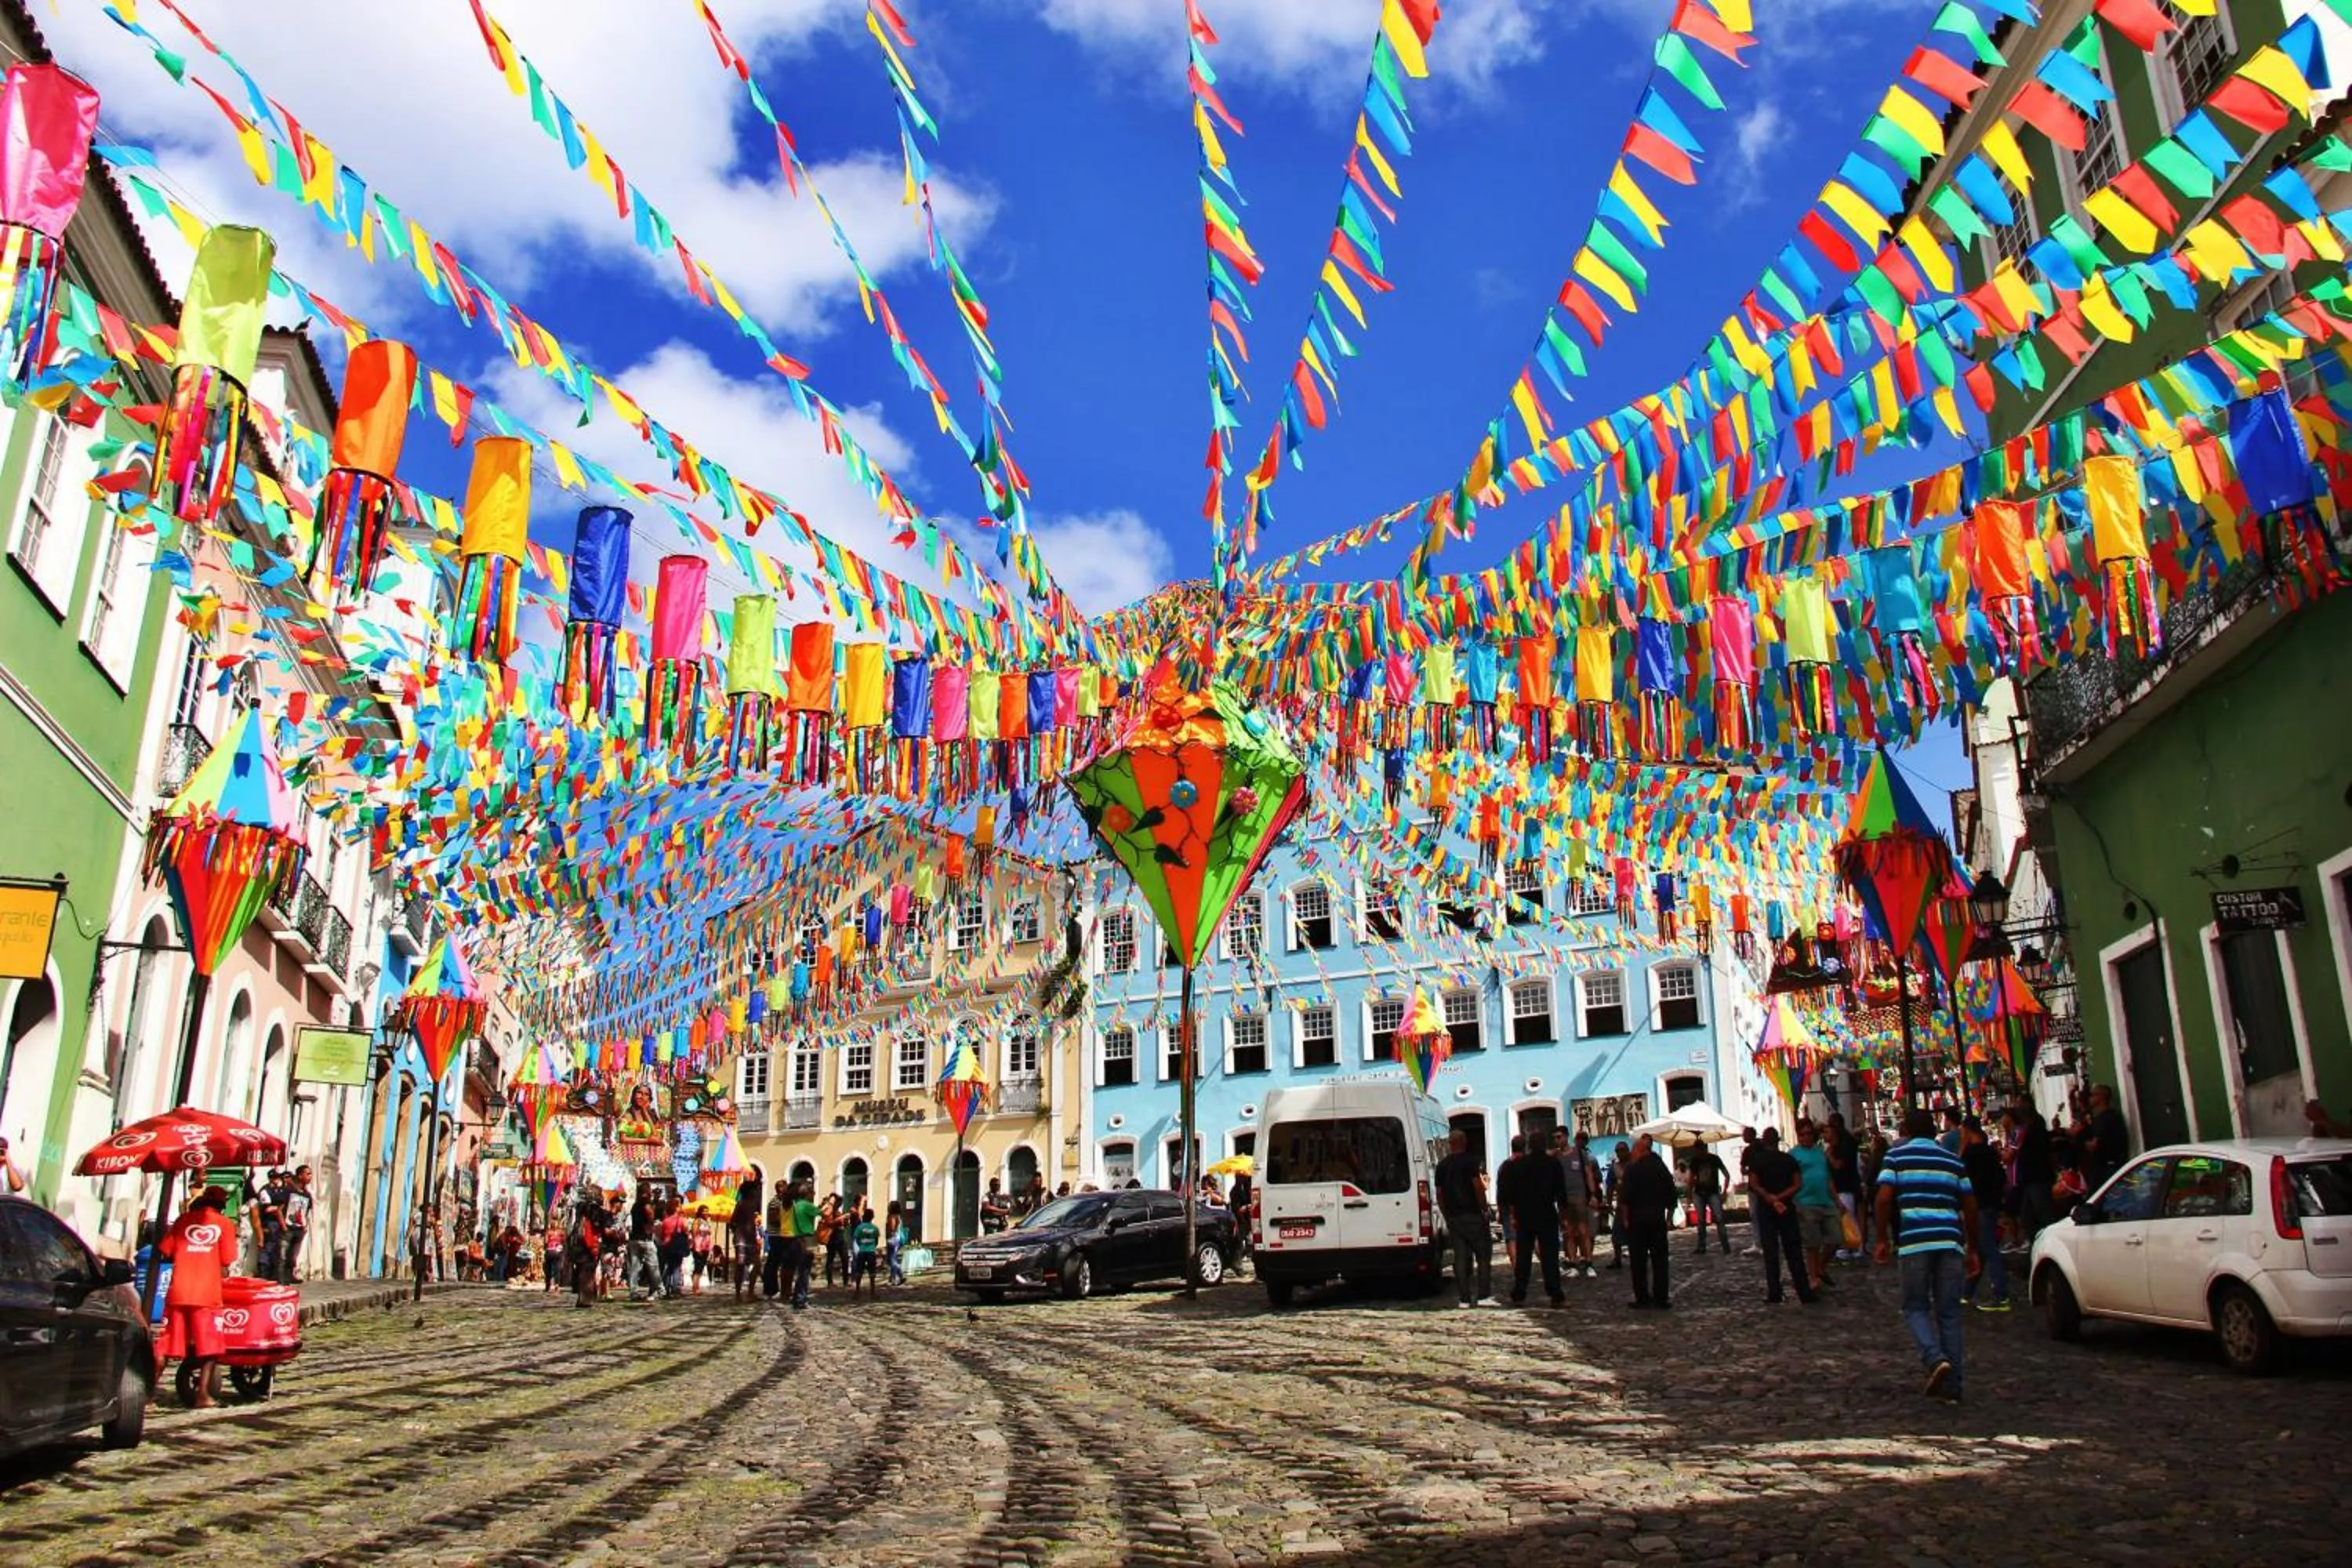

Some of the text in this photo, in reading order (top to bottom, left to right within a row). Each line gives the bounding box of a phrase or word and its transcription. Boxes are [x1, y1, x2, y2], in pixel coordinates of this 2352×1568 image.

[2219, 902, 2279, 919] TATTOO
[854, 1098, 909, 1113] MUSEU
[835, 1109, 925, 1127] DA CIDADE
[95, 1153, 140, 1170] KIBON
[247, 1149, 279, 1163] KIBON
